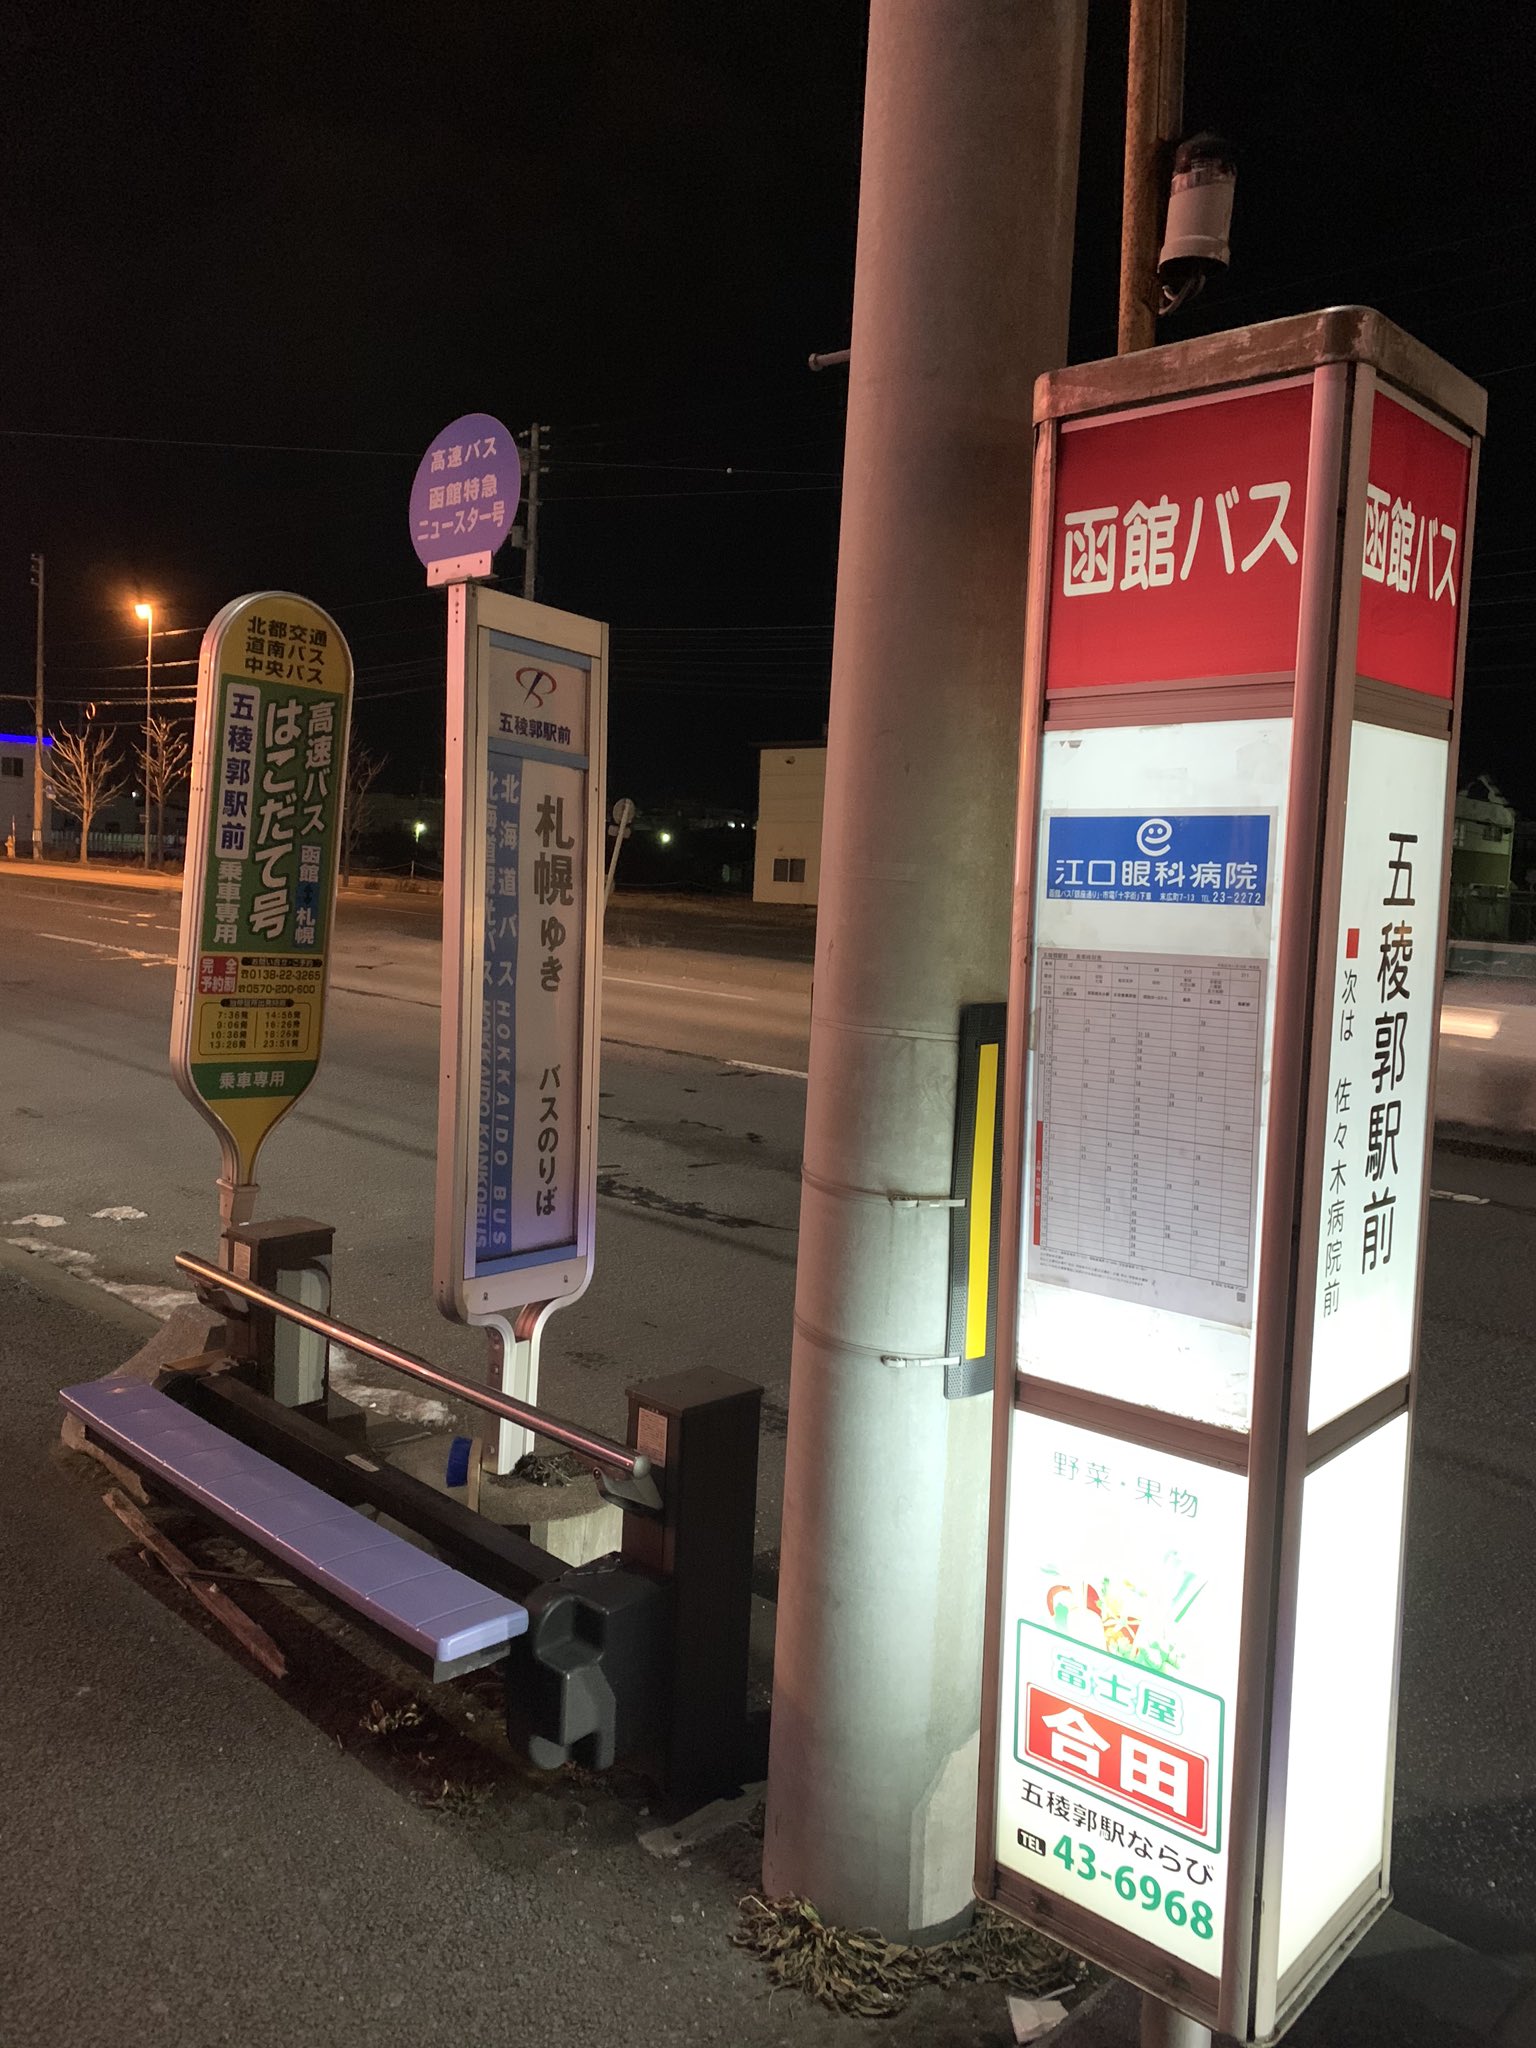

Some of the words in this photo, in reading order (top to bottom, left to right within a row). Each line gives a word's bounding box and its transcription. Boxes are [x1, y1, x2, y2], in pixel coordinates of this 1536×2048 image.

[428, 473, 498, 511] 函館特急
[431, 437, 497, 473] 高速バス
[417, 500, 505, 541] ニュースター号
[1063, 480, 1299, 597] 函館バス
[1362, 482, 1457, 606] 函館バス
[245, 636, 325, 666] 道南バス
[248, 615, 328, 648] 北都交通
[244, 656, 324, 685] 中央バス
[499, 712, 571, 746] 五稜郭駅前
[220, 692, 255, 851] 五稜郭駅前
[301, 701, 336, 836] 高速バス
[249, 699, 303, 939] はこだて号
[299, 845, 321, 883] 函館
[496, 773, 520, 987] 北海道バス
[533, 794, 575, 992] 札幌ゆき
[1055, 859, 1258, 890] 江口眼科病院
[1212, 891, 1262, 904] 23-2272
[213, 861, 243, 944] 乗車専用
[294, 907, 316, 945] 札幌
[1339, 969, 1358, 1042] 次は
[219, 1070, 285, 1090] 乗車専用
[493, 1001, 511, 1166] HOKKAIDO
[1361, 832, 1418, 1276] 五稜郭駅前
[536, 1064, 561, 1216] バスのりば
[492, 1185, 507, 1245] BUS
[1322, 1076, 1353, 1318] 佐々木病院前
[1053, 1451, 1199, 1518] 野菜・果物
[1056, 1653, 1177, 1728] 富士屋
[1041, 1707, 1189, 1817] 合田
[1020, 1778, 1215, 1885] 五稜郭駅ならび
[1019, 1831, 1044, 1855] TEL
[1053, 1834, 1215, 1940] 43-6968
